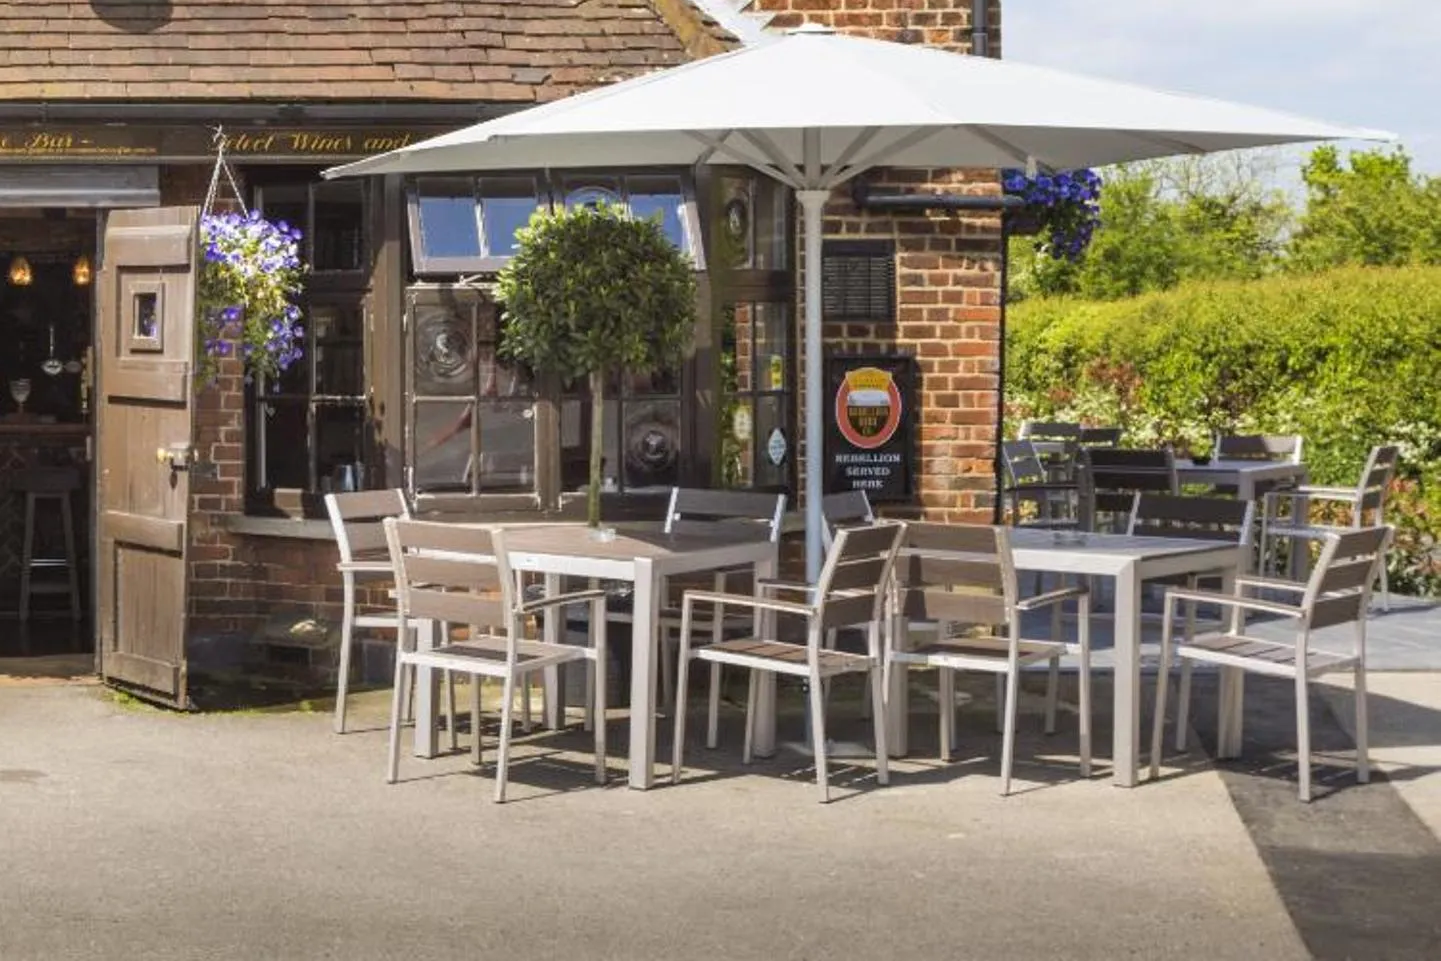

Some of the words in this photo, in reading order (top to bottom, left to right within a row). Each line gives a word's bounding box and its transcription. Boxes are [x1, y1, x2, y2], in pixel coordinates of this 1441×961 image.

[289, 132, 352, 150] Wines
[835, 453, 900, 463] REBELLION
[845, 466, 891, 476] SERVED
